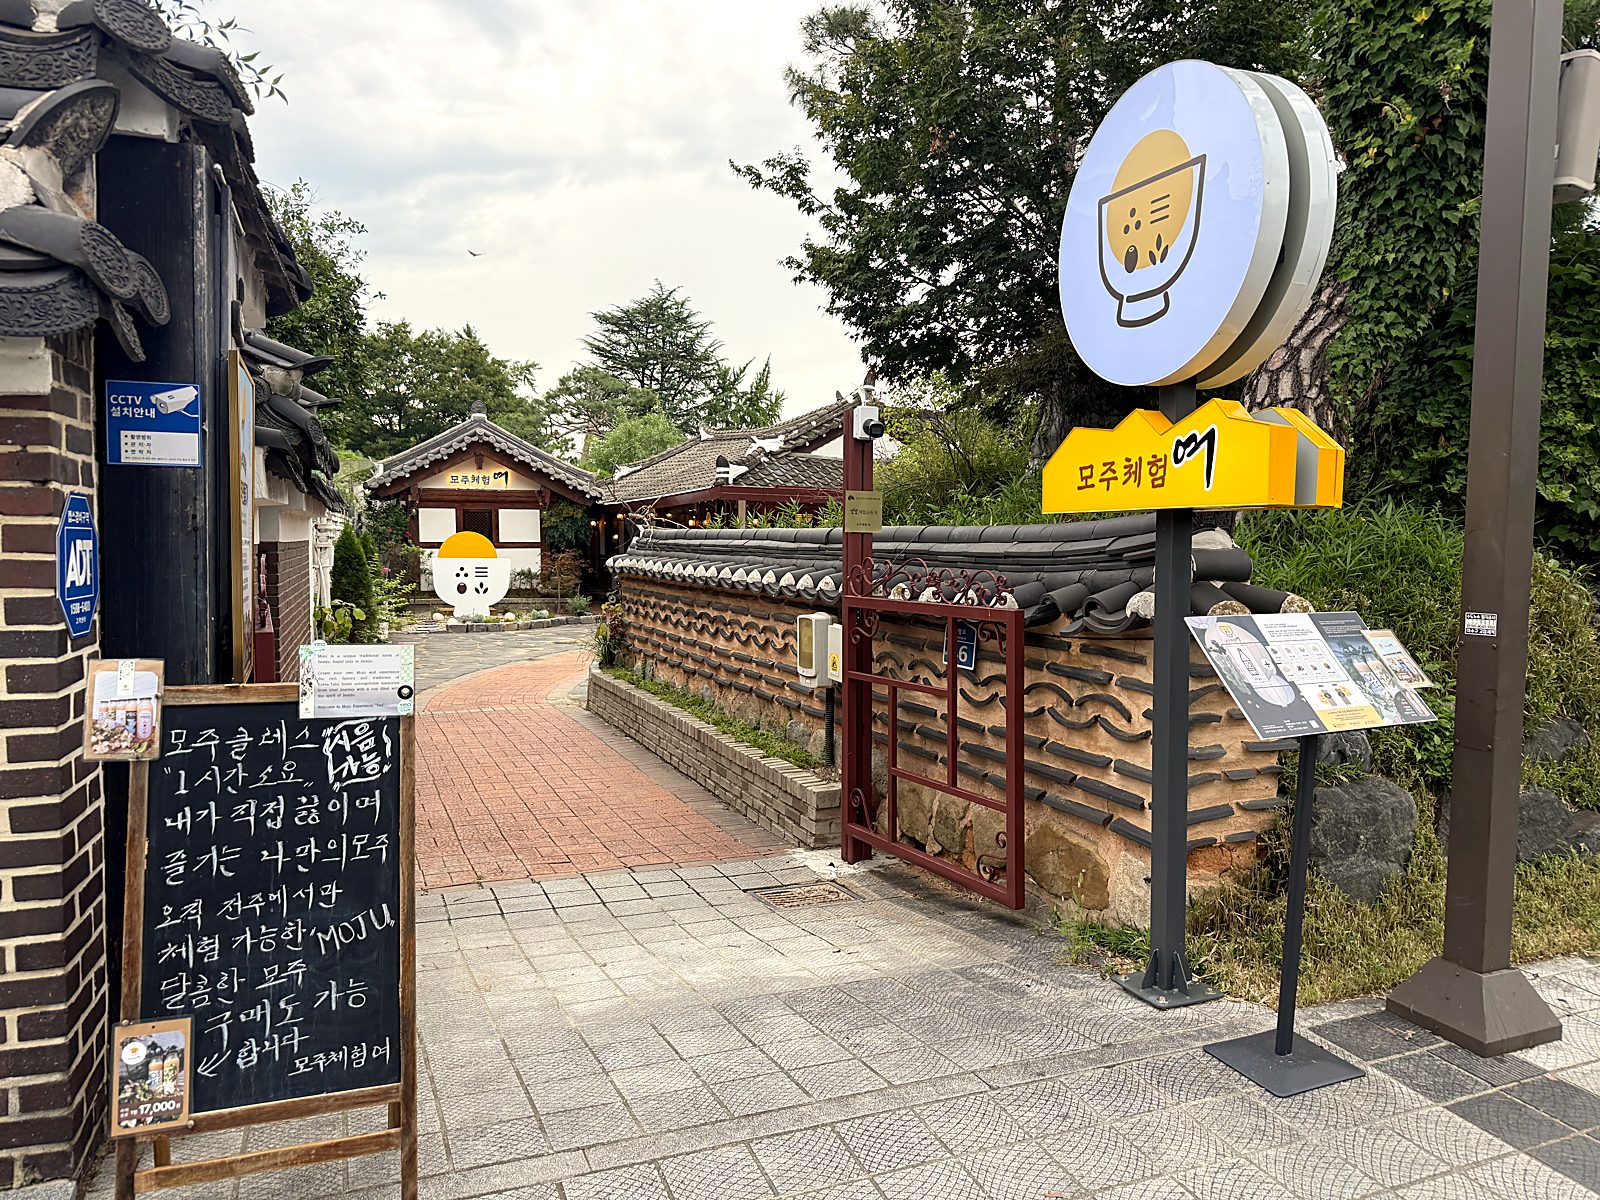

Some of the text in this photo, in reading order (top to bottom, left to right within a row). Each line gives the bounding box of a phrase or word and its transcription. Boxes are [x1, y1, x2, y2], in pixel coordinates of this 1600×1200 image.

[110, 394, 142, 405] CCTV
[110, 406, 156, 419] 설치안내
[450, 474, 490, 486] 모주체험
[1076, 453, 1168, 492] 모주체험
[66, 538, 92, 588] ADT
[958, 646, 968, 662] 6
[164, 800, 223, 836] 내가
[230, 794, 286, 837] 직접
[160, 845, 242, 886] 즐기는
[154, 880, 344, 931] 오직 전주에서만
[157, 934, 220, 969] 체험
[231, 918, 307, 955] 가능한
[159, 959, 308, 1010] 달콤한 모주
[204, 978, 369, 1051] 구매도 가능
